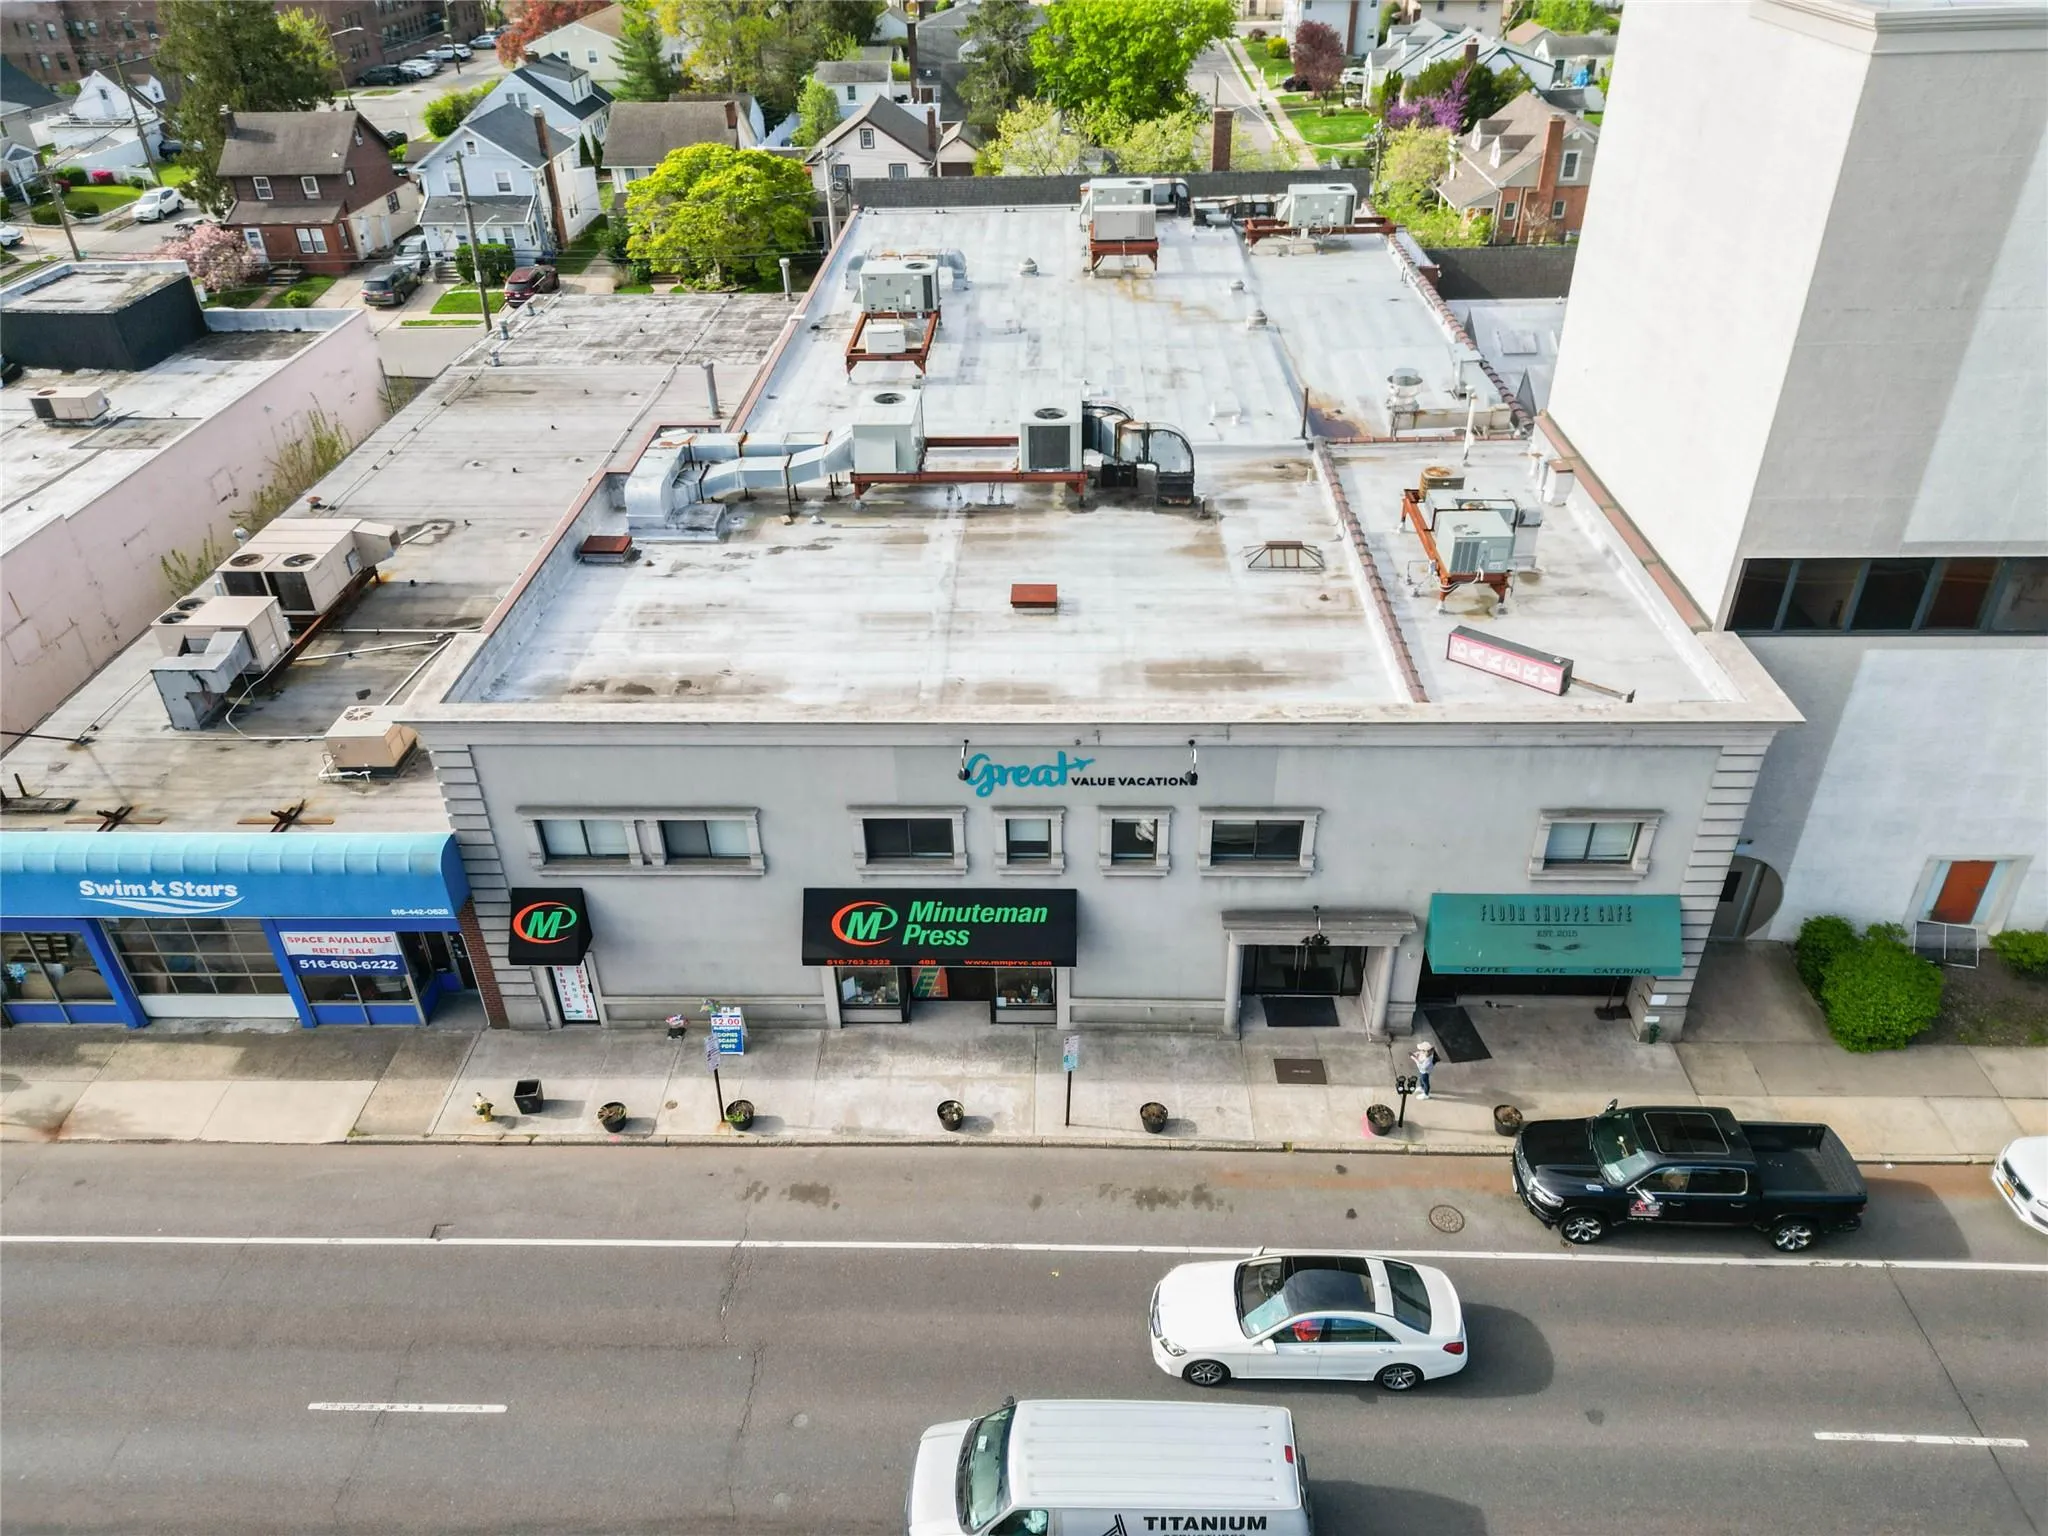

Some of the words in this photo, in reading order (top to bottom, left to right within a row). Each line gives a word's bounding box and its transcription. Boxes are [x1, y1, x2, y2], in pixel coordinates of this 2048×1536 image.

[1453, 642, 1558, 684] BAKERY
[967, 751, 1067, 798] Great
[1072, 777, 1115, 786] VALUE
[1119, 777, 1197, 786] VACATION
[79, 879, 147, 897] Swim
[169, 880, 238, 897] Stars
[908, 901, 1048, 923] Minuteman
[1481, 903, 1525, 922] FLOUR
[1534, 903, 1590, 922] SHOPPE
[1598, 903, 1633, 922] CAFE
[287, 936, 324, 944] SPACE
[328, 935, 393, 944] AVAILABLE
[902, 924, 970, 946] Press
[1557, 929, 1578, 938] 2015
[299, 959, 399, 970] 516-680-6222
[964, 959, 1053, 967] www.mmprvc.com
[556, 966, 572, 1008] RINTING
[1143, 1516, 1267, 1531] TITANIUM
